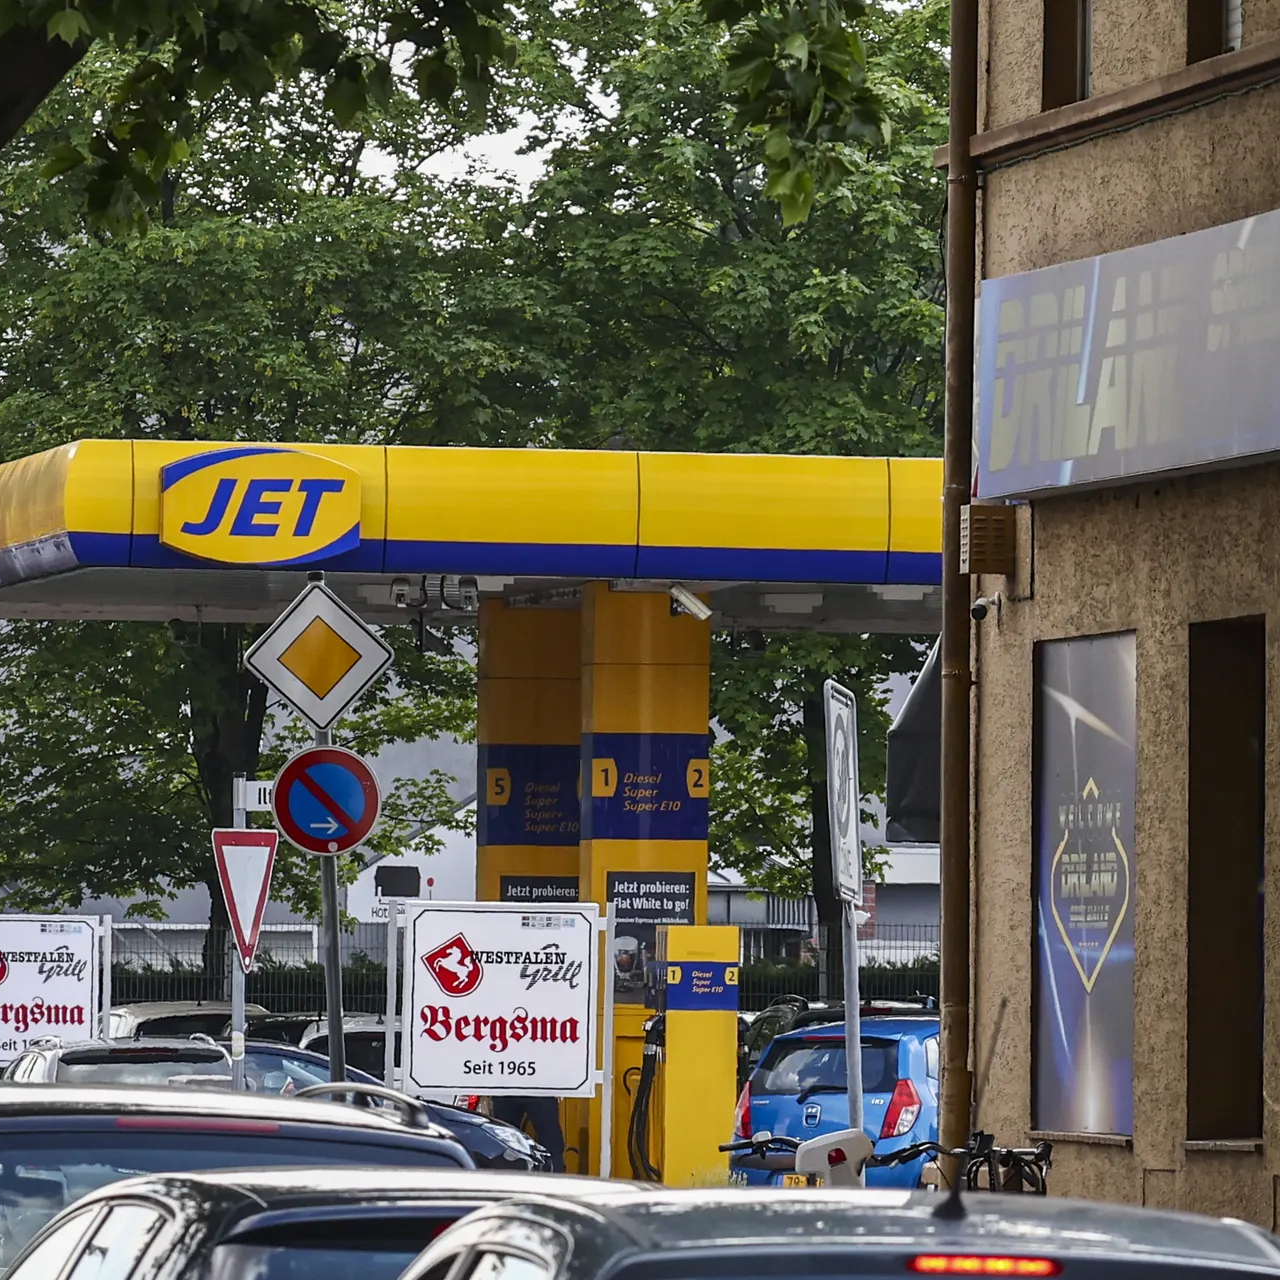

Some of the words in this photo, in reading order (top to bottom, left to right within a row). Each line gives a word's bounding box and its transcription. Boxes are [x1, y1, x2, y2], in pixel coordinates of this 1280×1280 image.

[180, 477, 346, 538] JET
[600, 768, 609, 787] 1
[692, 768, 704, 788] 2
[623, 773, 662, 784] Diesel
[494, 778, 505, 796] 5
[524, 782, 561, 793] Diesel
[623, 787, 659, 800] Super
[523, 796, 558, 807] Super
[623, 801, 658, 813] Super
[660, 800, 681, 812] E10
[524, 822, 557, 834] Super
[559, 821, 579, 832] E10
[506, 885, 532, 898] Jetzt
[532, 884, 579, 899] probieren:
[613, 881, 638, 894] Jetzt
[639, 881, 690, 896] probieren:
[613, 897, 631, 910] Flat
[632, 897, 662, 910] White
[663, 898, 673, 910] to
[675, 897, 689, 913] go!
[0, 951, 75, 964] WESTFALEN
[470, 951, 567, 965] WESTFALEN
[671, 969, 676, 980] 1
[728, 970, 735, 981] 2
[692, 970, 712, 978] Diesel
[692, 978, 711, 986] Super
[692, 986, 711, 994] Super
[420, 1004, 580, 1053] Bergsma
[463, 1060, 494, 1075] Seit
[498, 1061, 537, 1076] 1965
